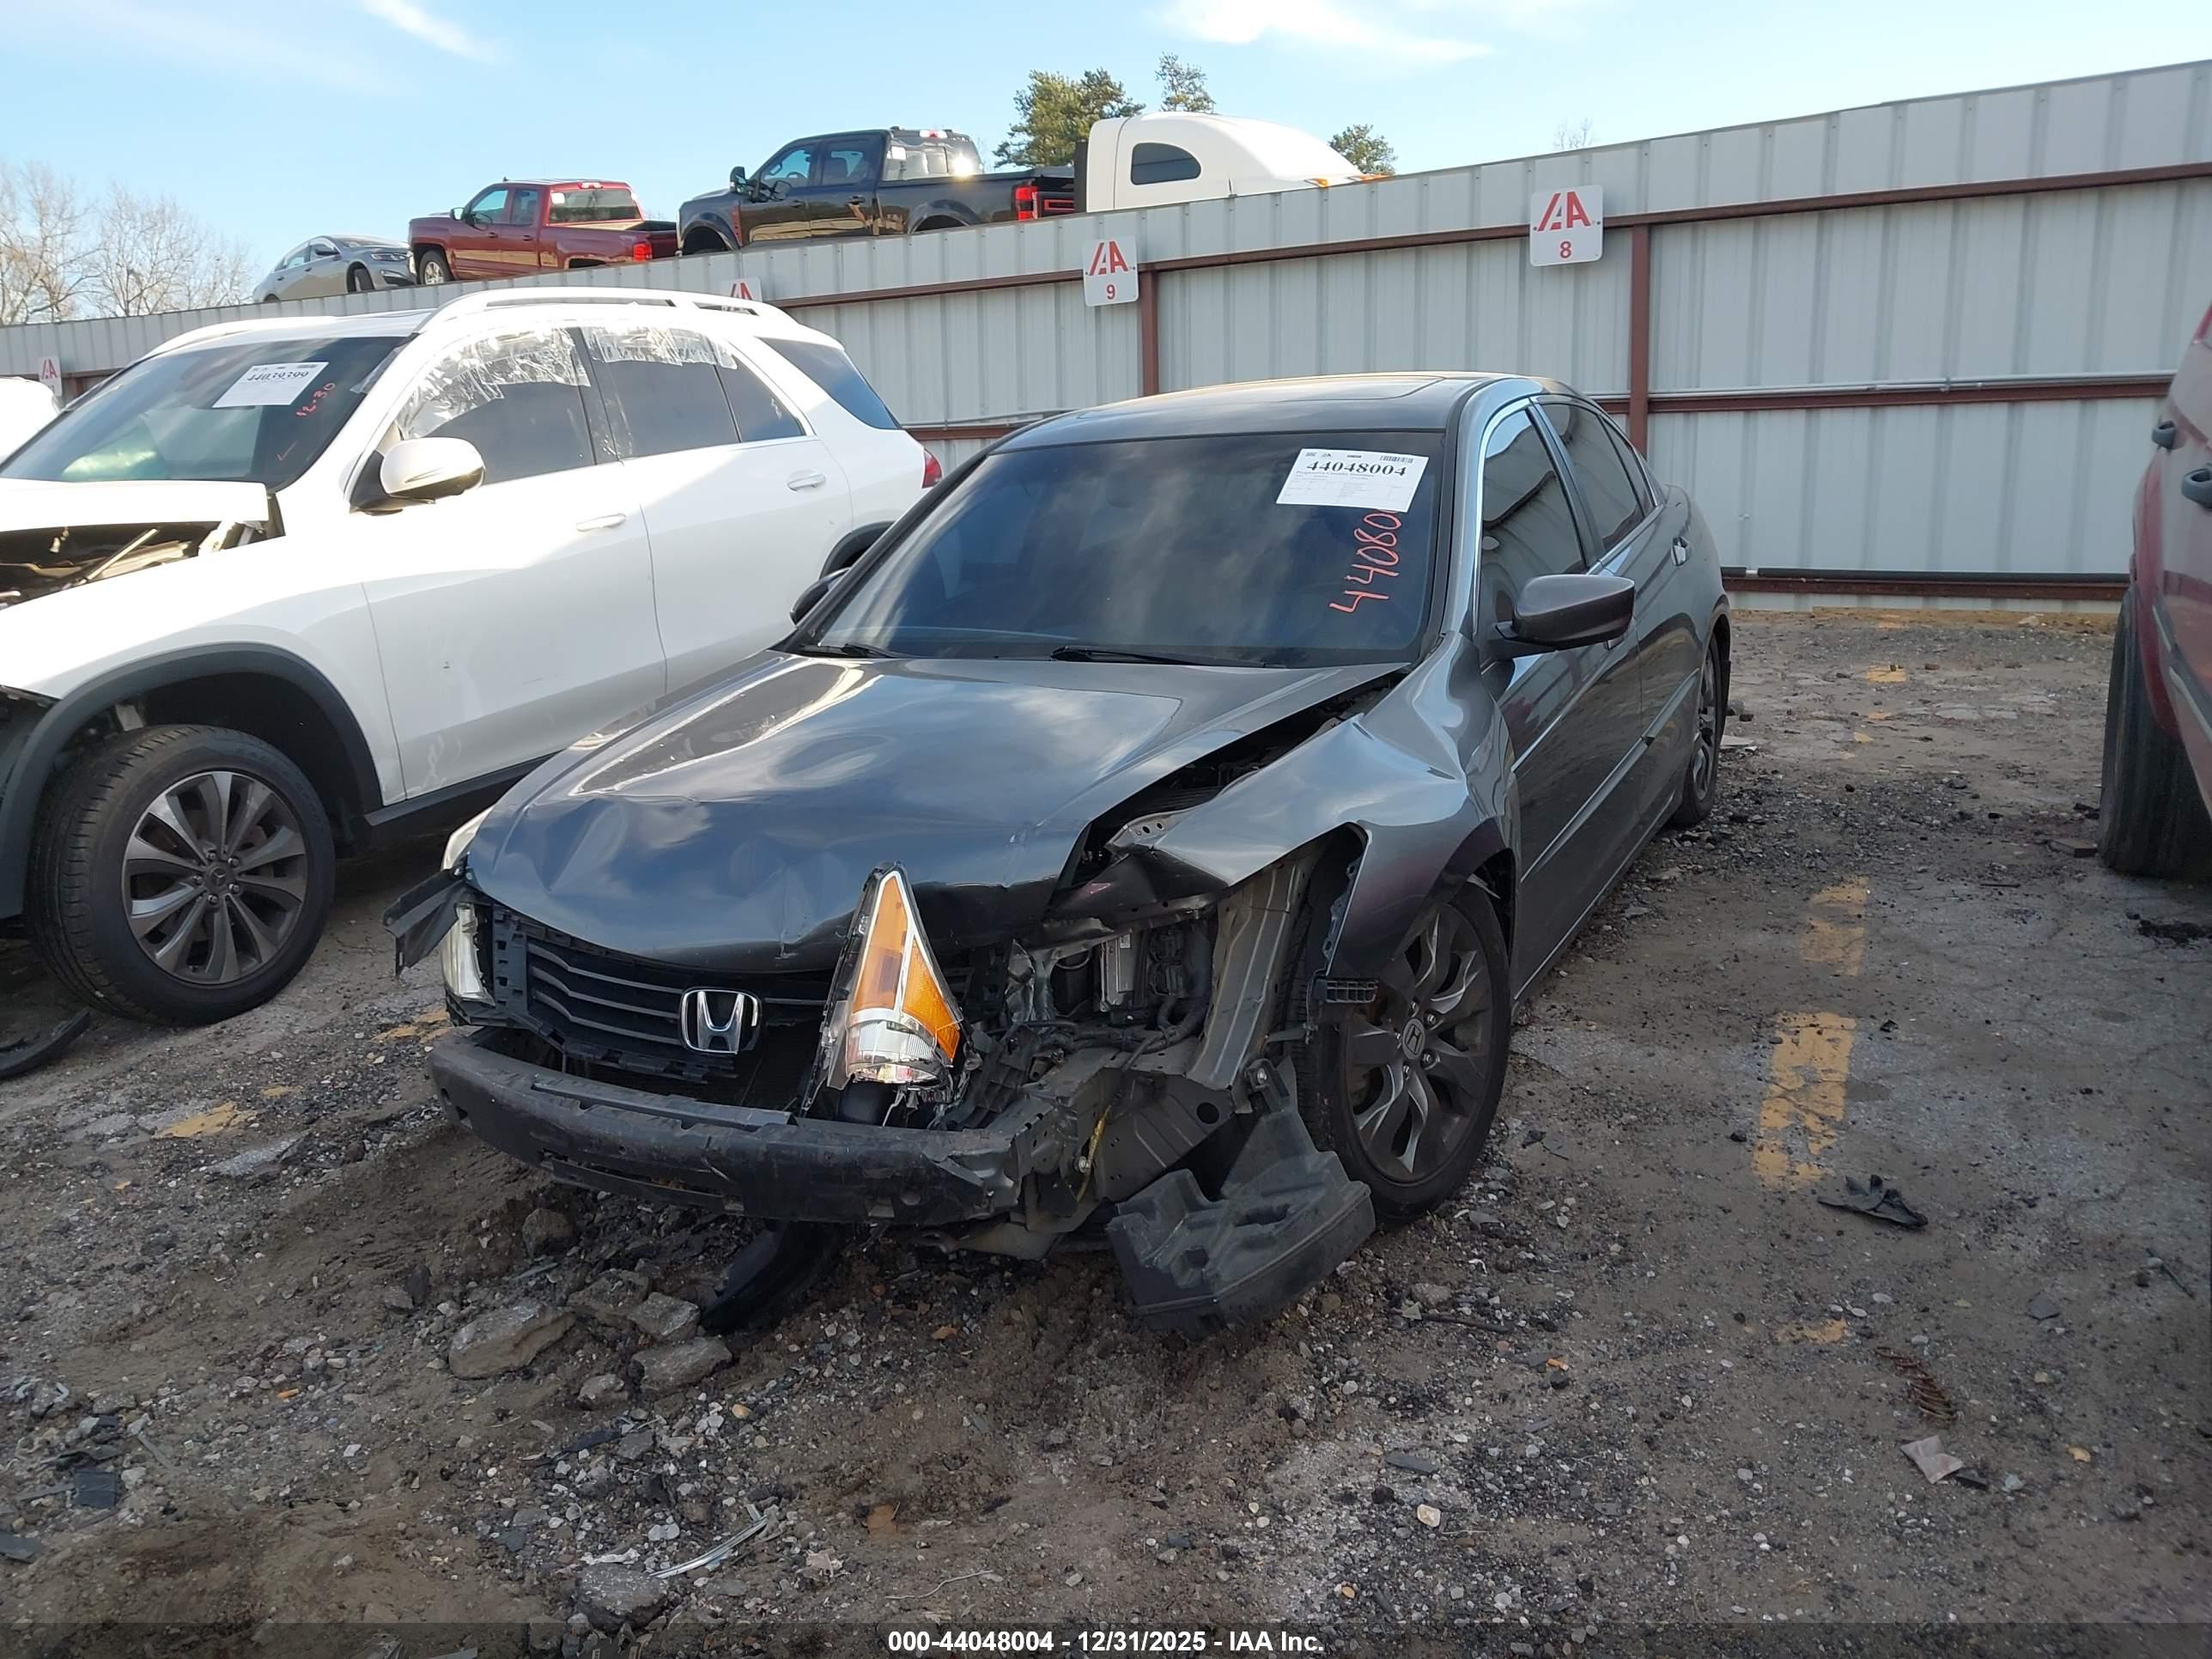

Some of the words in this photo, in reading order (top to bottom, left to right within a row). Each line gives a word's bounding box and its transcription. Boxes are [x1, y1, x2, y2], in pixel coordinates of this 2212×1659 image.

[1559, 240, 1572, 258] 8
[1106, 283, 1115, 300] 9
[1306, 460, 1407, 477] 44048004
[1329, 509, 1402, 612] 44080
